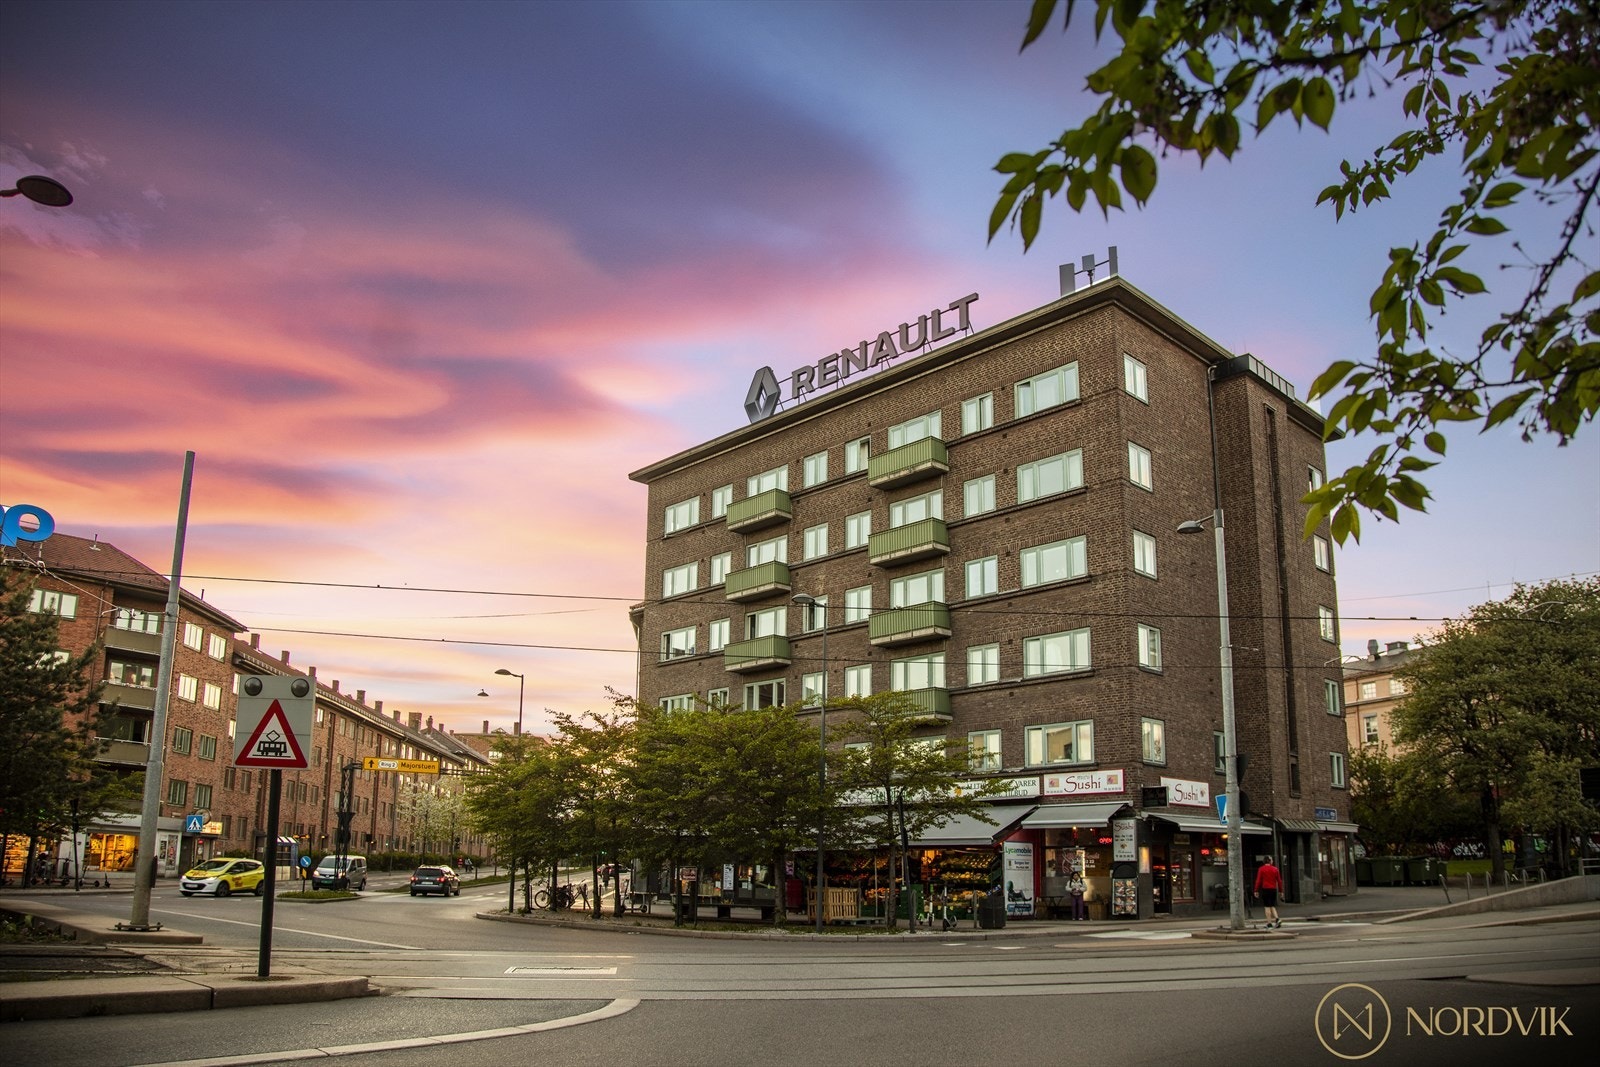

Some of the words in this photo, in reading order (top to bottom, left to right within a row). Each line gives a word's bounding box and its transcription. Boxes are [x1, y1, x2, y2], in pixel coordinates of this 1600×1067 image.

[792, 292, 979, 399] RENAULT
[0, 503, 55, 548] p
[401, 762, 436, 770] Majorstuen
[1015, 779, 1037, 787] VARER
[1064, 774, 1102, 793] Sushi
[1005, 789, 1029, 797] TILBUD
[1174, 783, 1198, 802] Sushi
[1114, 821, 1134, 832] Sushi
[1098, 836, 1113, 845] OPEN
[1005, 846, 1033, 855] Lycamobile
